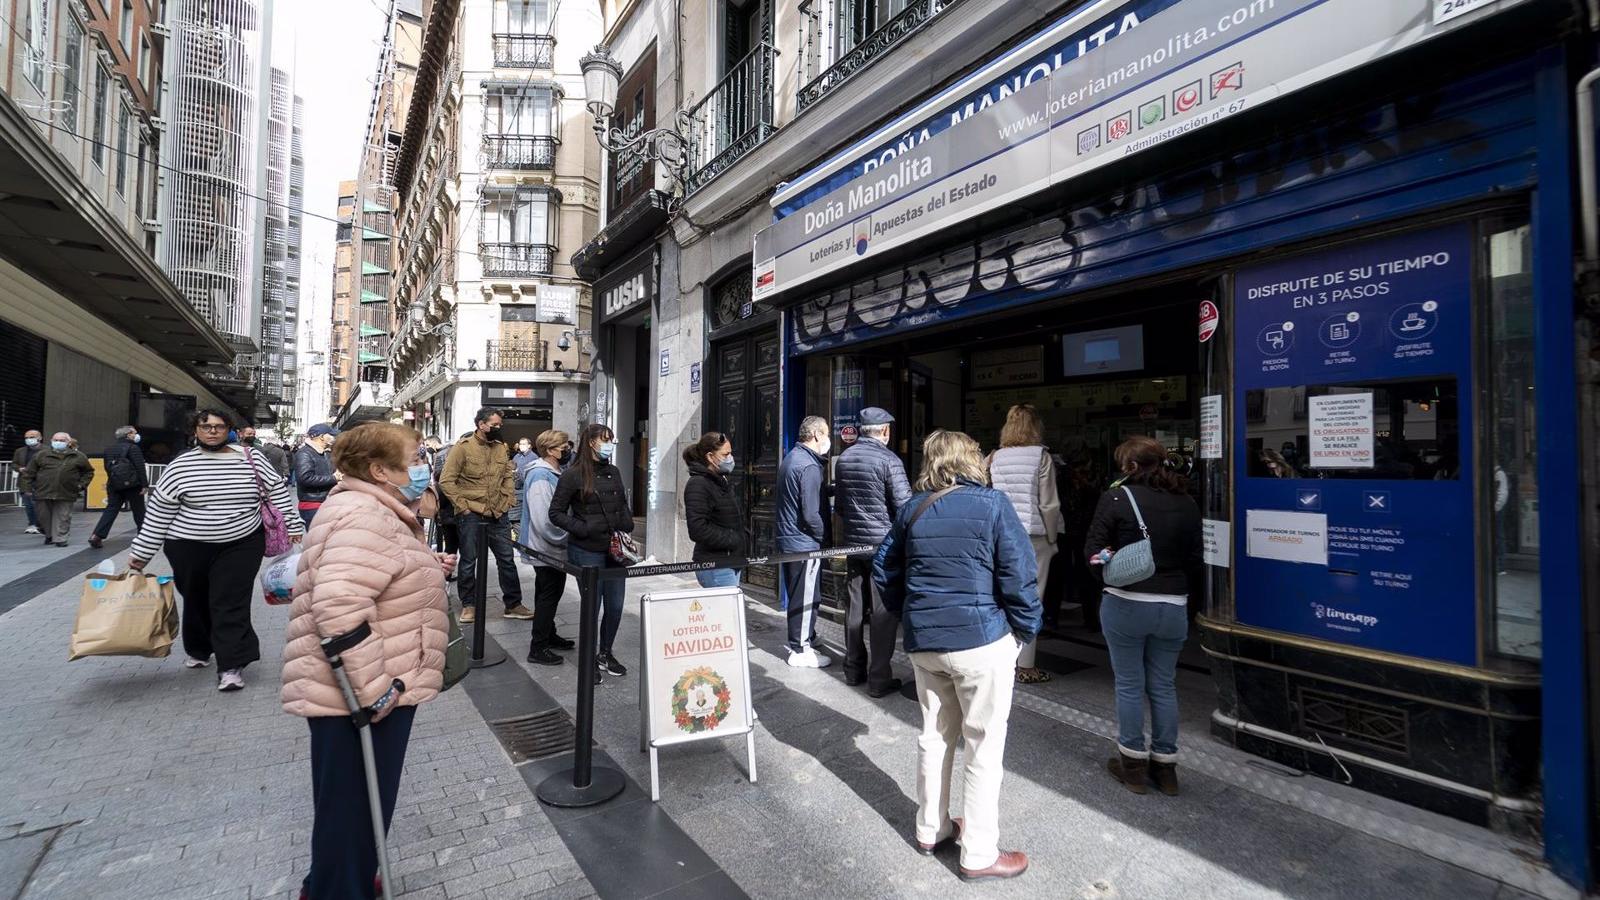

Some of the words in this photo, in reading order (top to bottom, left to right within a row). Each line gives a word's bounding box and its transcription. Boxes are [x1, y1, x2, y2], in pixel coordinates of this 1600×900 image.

[998, 0, 1275, 141] www.loteriamanolita.com
[623, 108, 645, 139] USH
[1125, 117, 1208, 155] Administración
[1229, 99, 1246, 114] 67
[804, 199, 844, 235] Doña
[848, 155, 932, 210] Manolita
[809, 239, 845, 263] Loterías
[845, 238, 851, 251] y
[874, 204, 923, 236] Apuestas
[927, 191, 946, 212] del
[950, 173, 998, 201] Estado
[1248, 276, 1319, 300] DISFRUTE
[1323, 271, 1345, 286] DE
[1349, 266, 1372, 281] SU
[1377, 252, 1449, 278] TIEMPO
[606, 273, 645, 315] LUSH
[1293, 295, 1313, 309] EN
[1317, 291, 1328, 305] 3
[1332, 281, 1390, 303] PASOS
[809, 545, 874, 558] WWW.LOTERIAMANOLITA.COM
[627, 561, 716, 576] WWW.LOTERIAMANOLITA.COM
[673, 626, 709, 636] LOTERIA
[711, 623, 722, 633] DE
[688, 614, 705, 623] HAY
[663, 635, 734, 657] NAVIDAD
